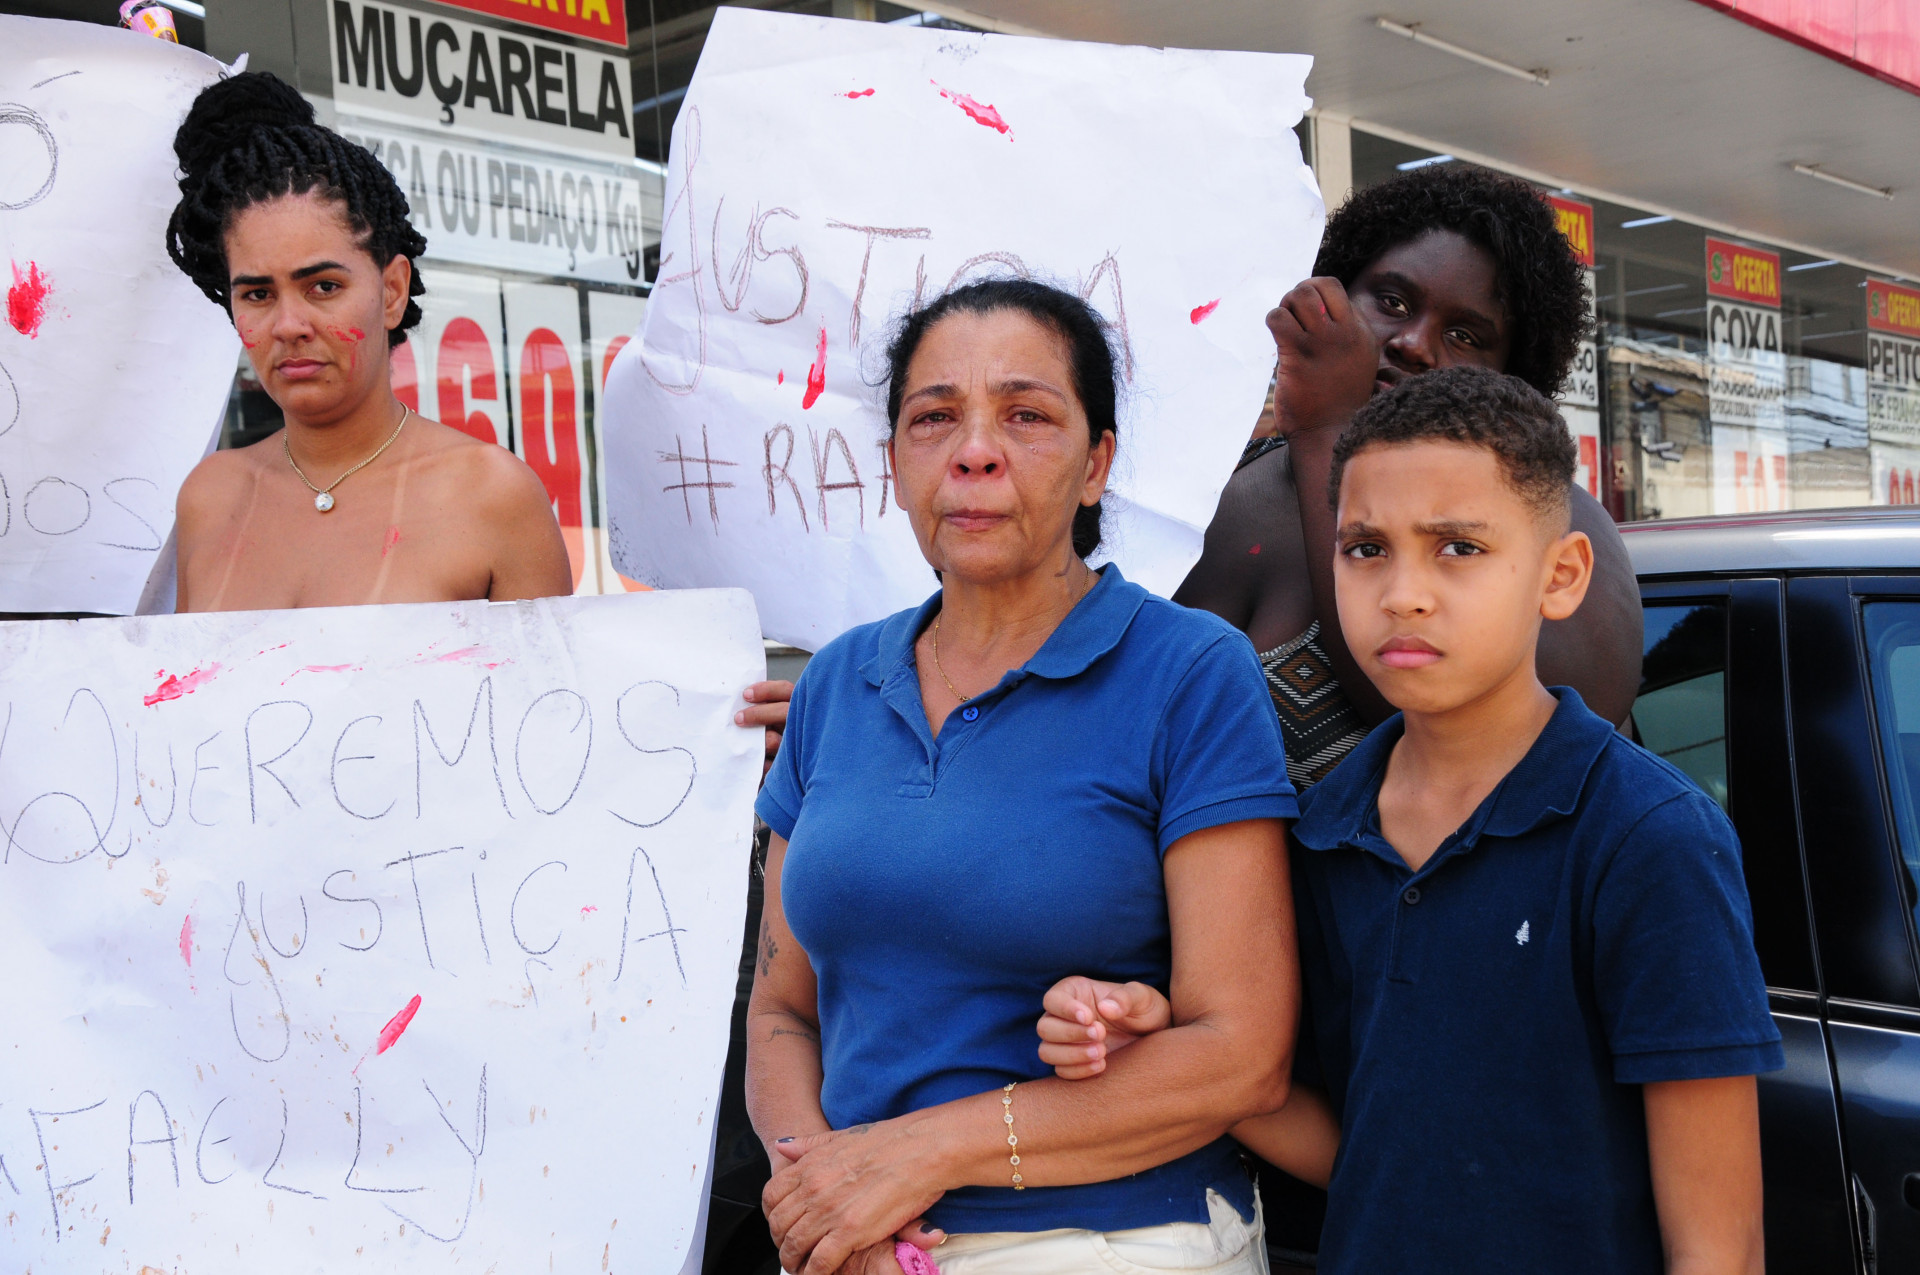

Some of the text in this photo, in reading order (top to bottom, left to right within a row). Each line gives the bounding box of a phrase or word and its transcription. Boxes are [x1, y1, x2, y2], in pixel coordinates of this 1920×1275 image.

[333, 0, 630, 138] MUÇARELA
[437, 150, 480, 236] OU
[487, 158, 598, 271] PEDAÇO
[604, 180, 640, 280] Kg
[641, 104, 1132, 395] JUSTIA
[1733, 254, 1777, 298] OFERTA
[1710, 305, 1778, 360] COXA
[0, 676, 698, 864] QUEREMOS
[0, 1062, 488, 1243] FAELLY
